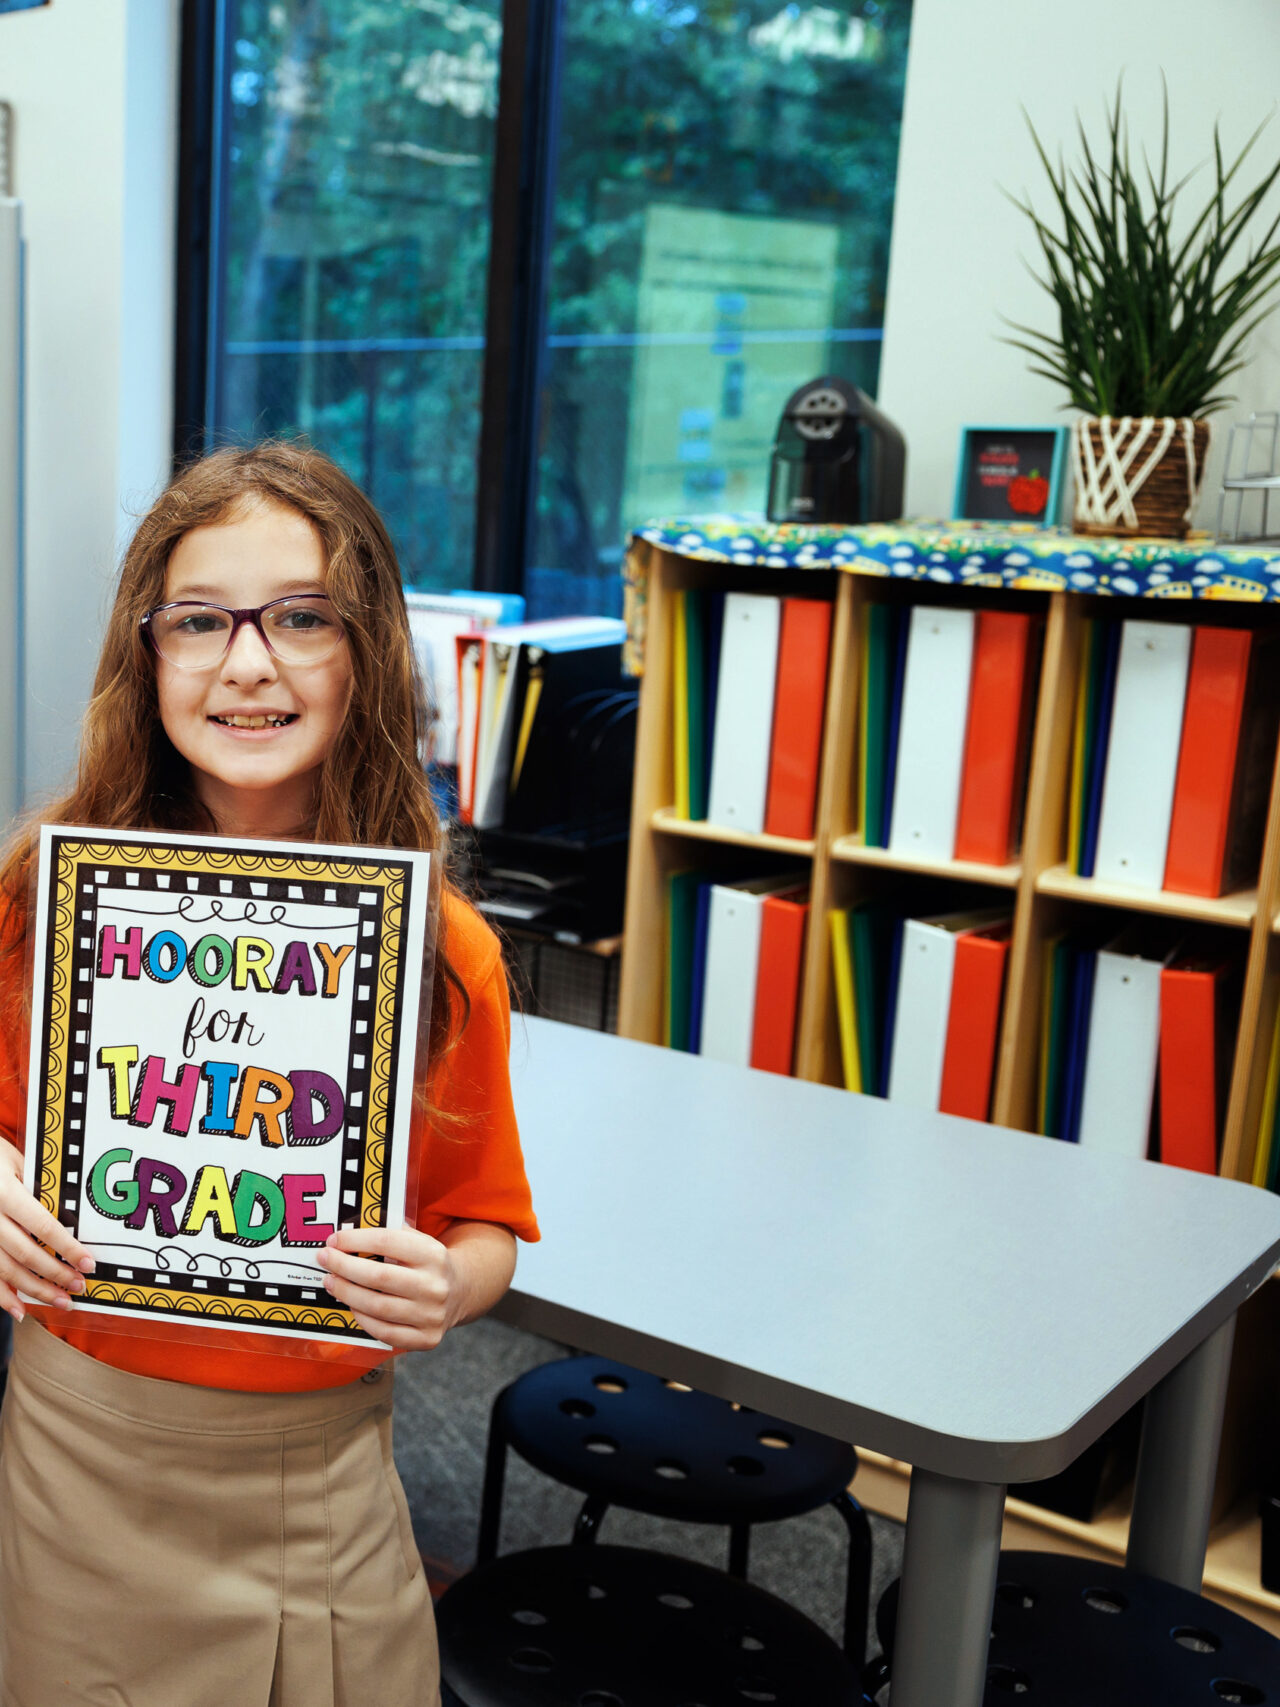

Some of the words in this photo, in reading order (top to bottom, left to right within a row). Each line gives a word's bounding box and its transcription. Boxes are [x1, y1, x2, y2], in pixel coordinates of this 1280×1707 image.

[95, 924, 356, 999] HOORAY
[182, 997, 266, 1059] for
[96, 1044, 347, 1149] THIRD
[86, 1147, 337, 1249] GRADE
